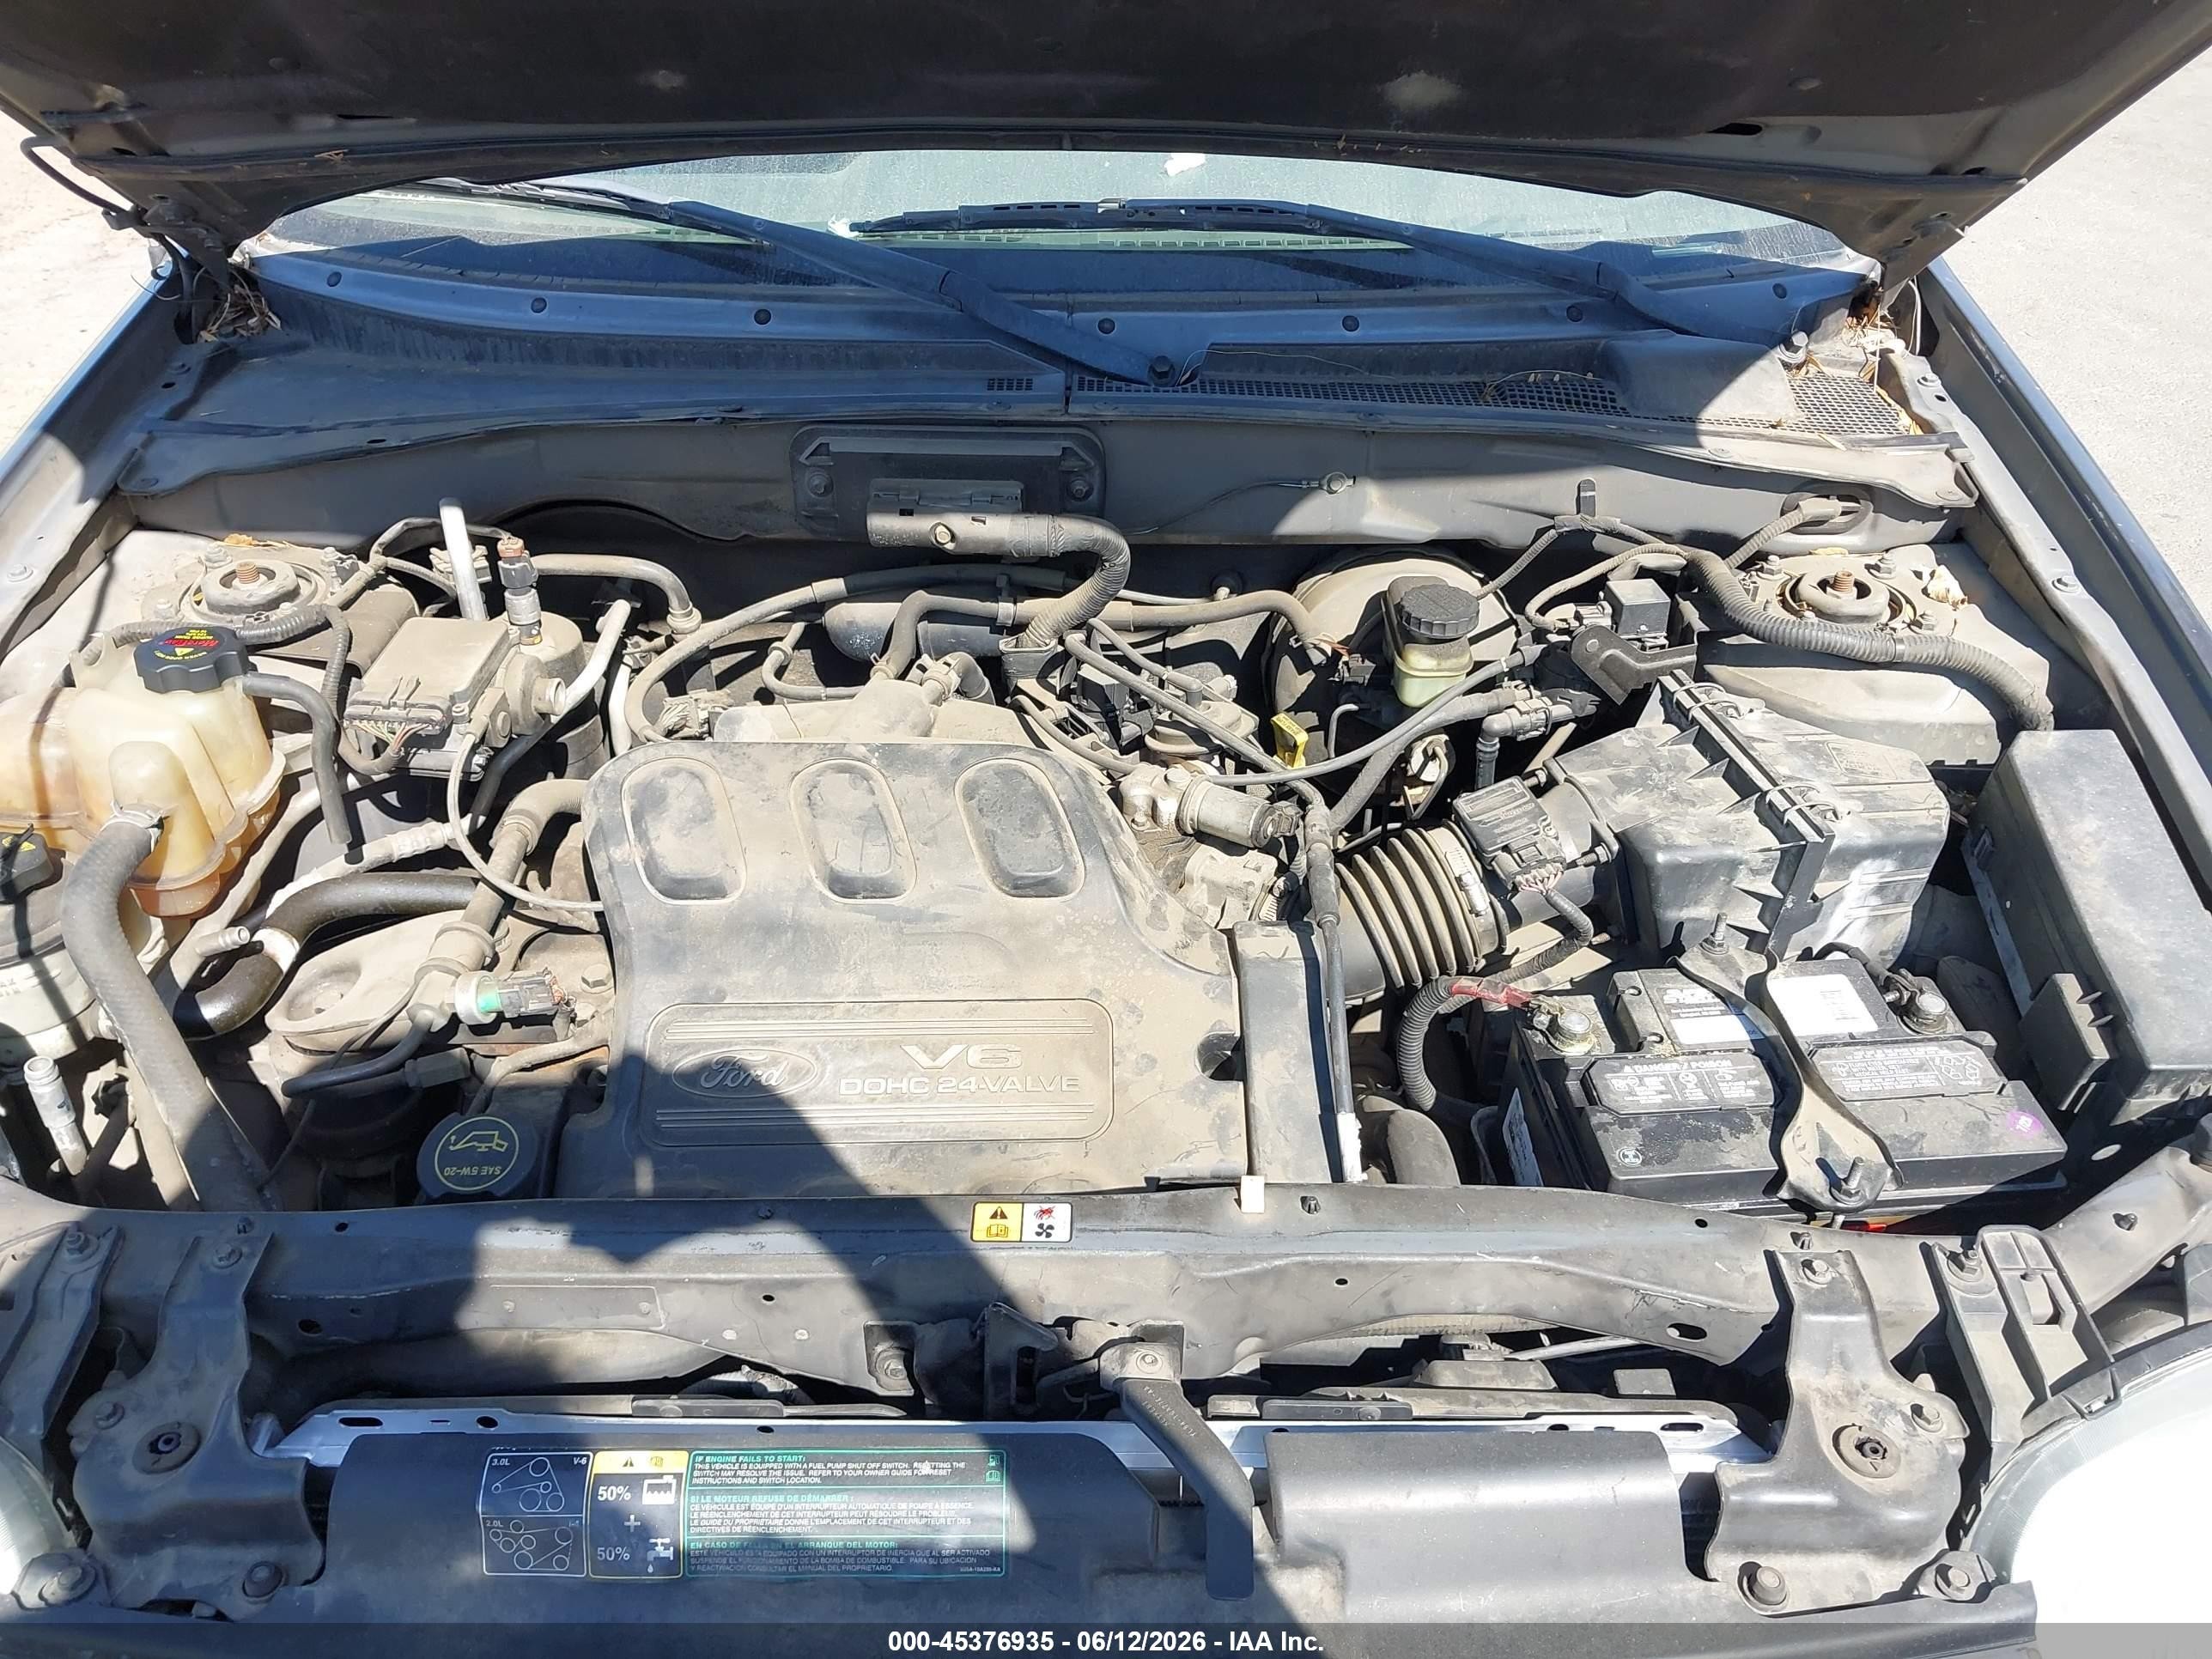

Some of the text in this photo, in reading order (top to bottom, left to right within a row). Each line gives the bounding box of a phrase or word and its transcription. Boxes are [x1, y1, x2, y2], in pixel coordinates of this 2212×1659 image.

[901, 1044, 1022, 1069] V6
[701, 1054, 788, 1089] Ford
[1633, 1063, 1680, 1073] DANGER
[1690, 1060, 1732, 1069] POISON
[839, 1075, 1079, 1096] DOHC 24-VALVE
[443, 1166, 501, 1176] SAE 5W-20
[597, 1485, 631, 1501] 50%
[801, 1493, 848, 1502] DÉMARRER
[597, 1547, 630, 1561] 50%
